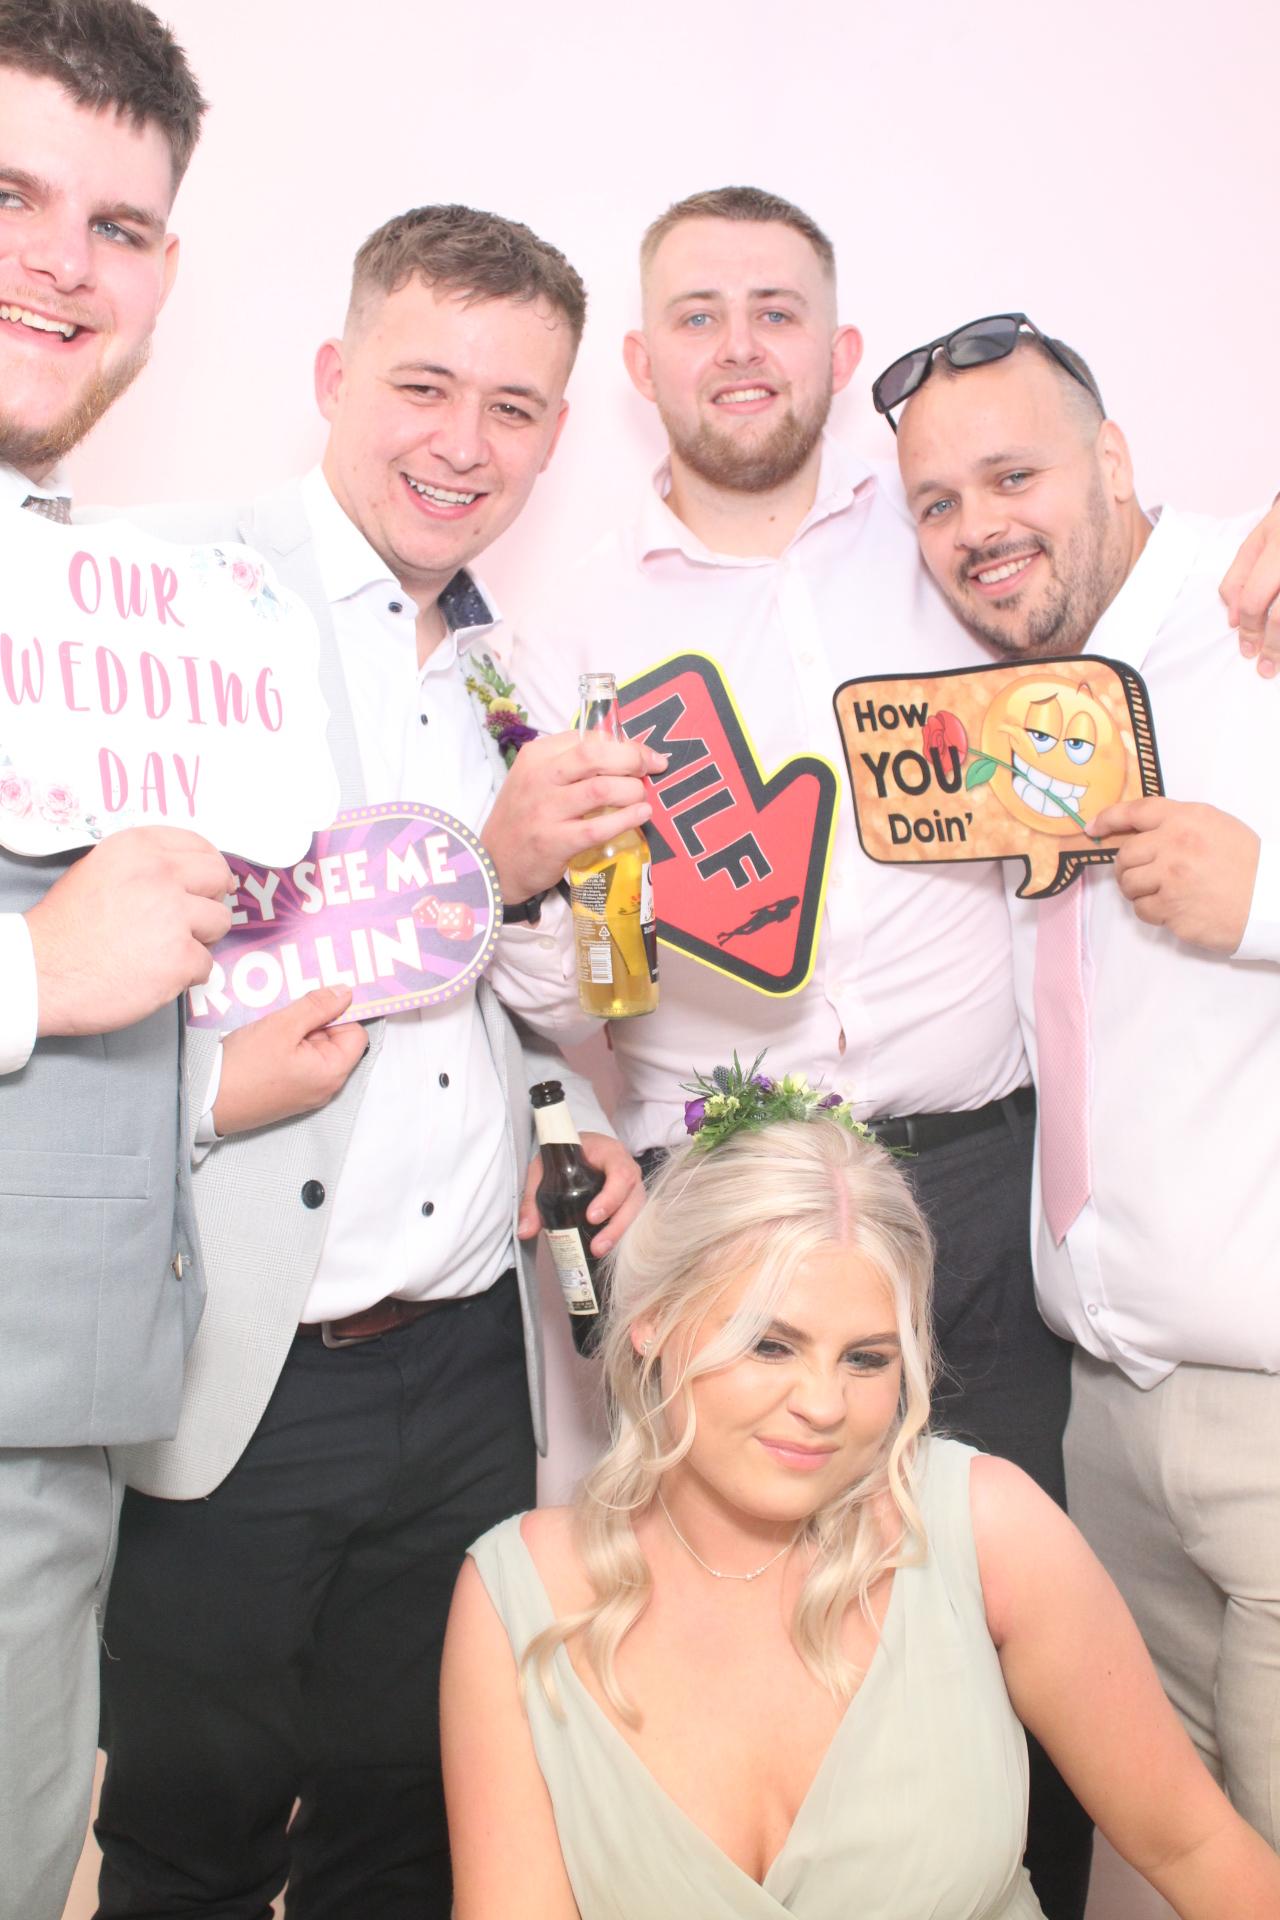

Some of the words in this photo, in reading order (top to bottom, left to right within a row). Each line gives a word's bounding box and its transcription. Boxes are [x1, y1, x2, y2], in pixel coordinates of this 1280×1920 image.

[69, 551, 185, 628] OUR
[0, 632, 283, 732] WEDDING
[853, 700, 928, 733] How
[98, 747, 200, 818] DAY
[621, 692, 774, 891] MILF
[860, 746, 963, 799] YOU
[888, 809, 973, 845] Doin'
[292, 850, 376, 914] SEE
[386, 833, 457, 893] ME
[188, 916, 424, 1018] ROLLIN
